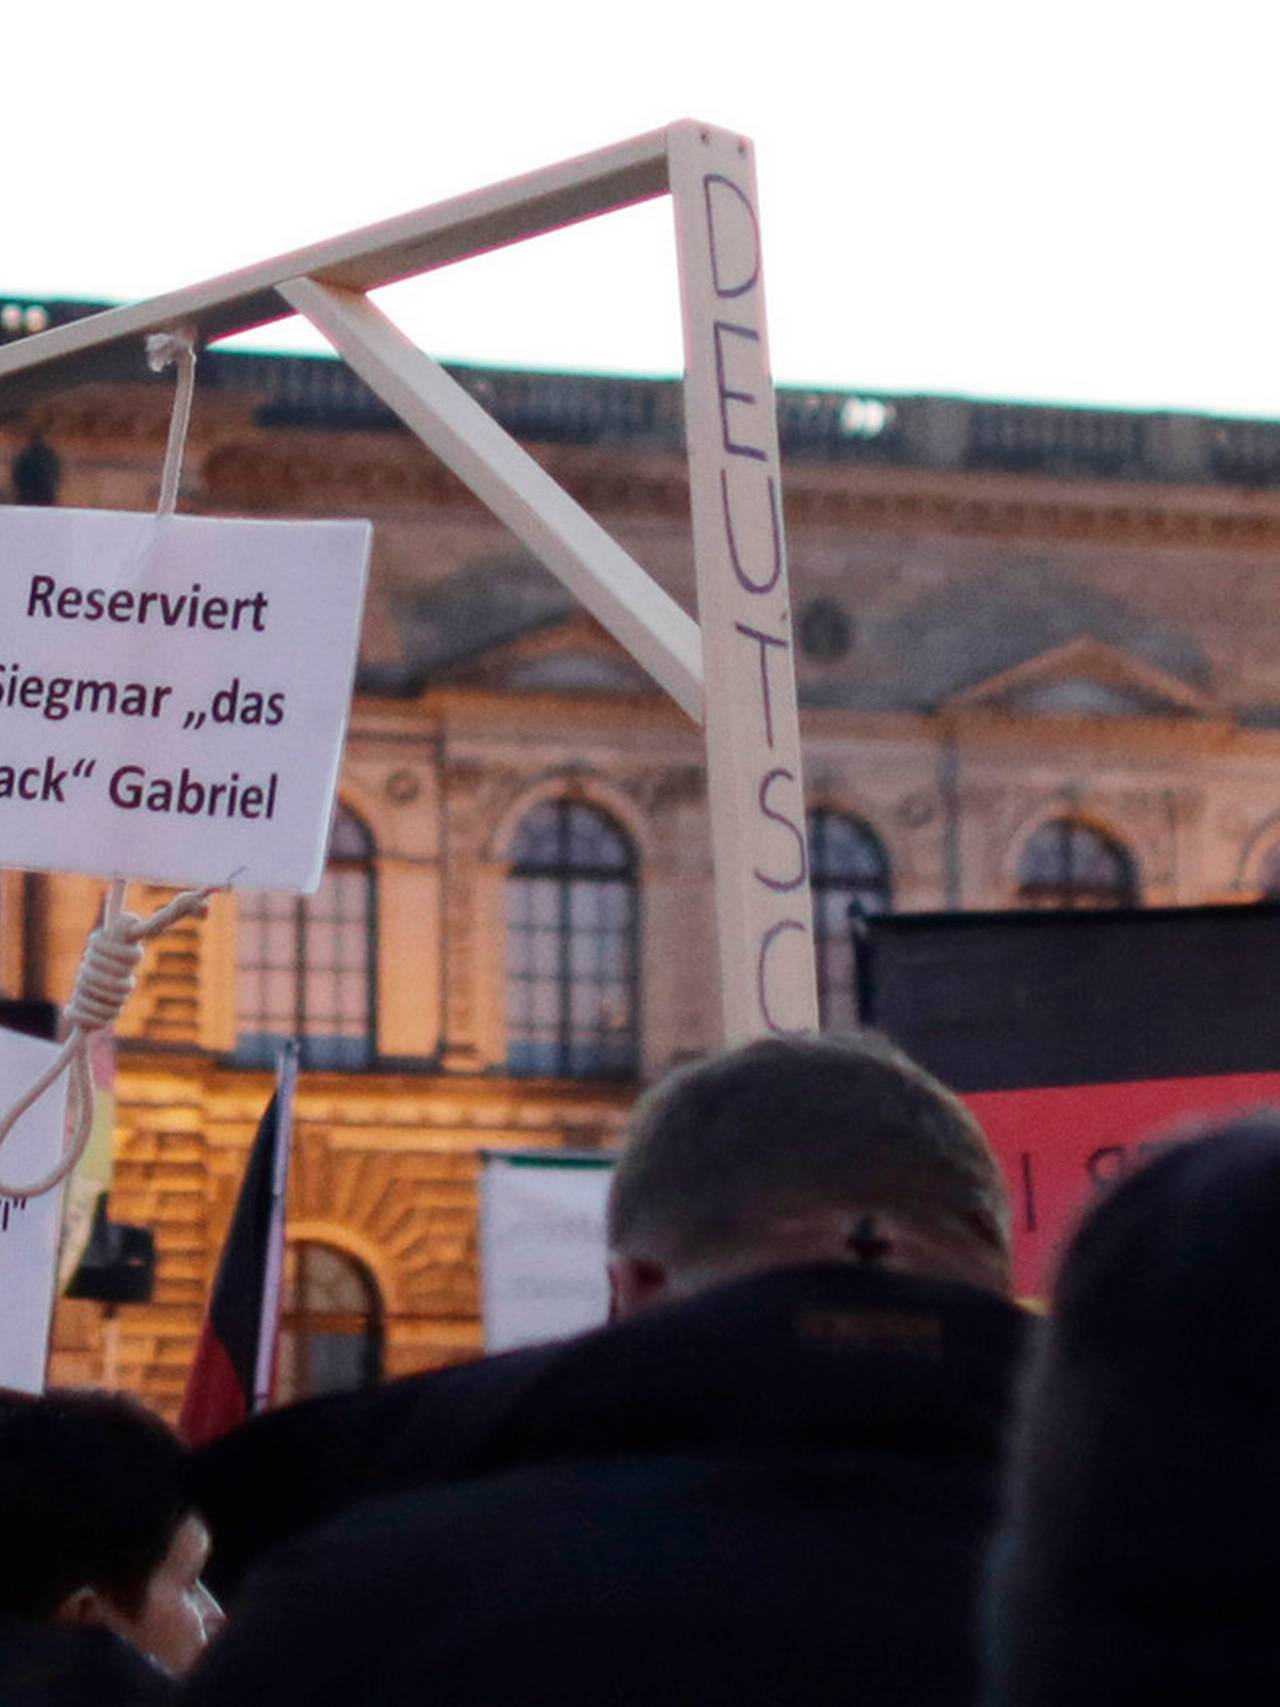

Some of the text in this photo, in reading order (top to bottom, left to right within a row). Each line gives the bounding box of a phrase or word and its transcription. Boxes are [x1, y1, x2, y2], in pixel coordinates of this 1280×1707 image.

[25, 574, 269, 632] Reserviert
[181, 677, 287, 730] „das
[108, 763, 279, 820] Gabriel
